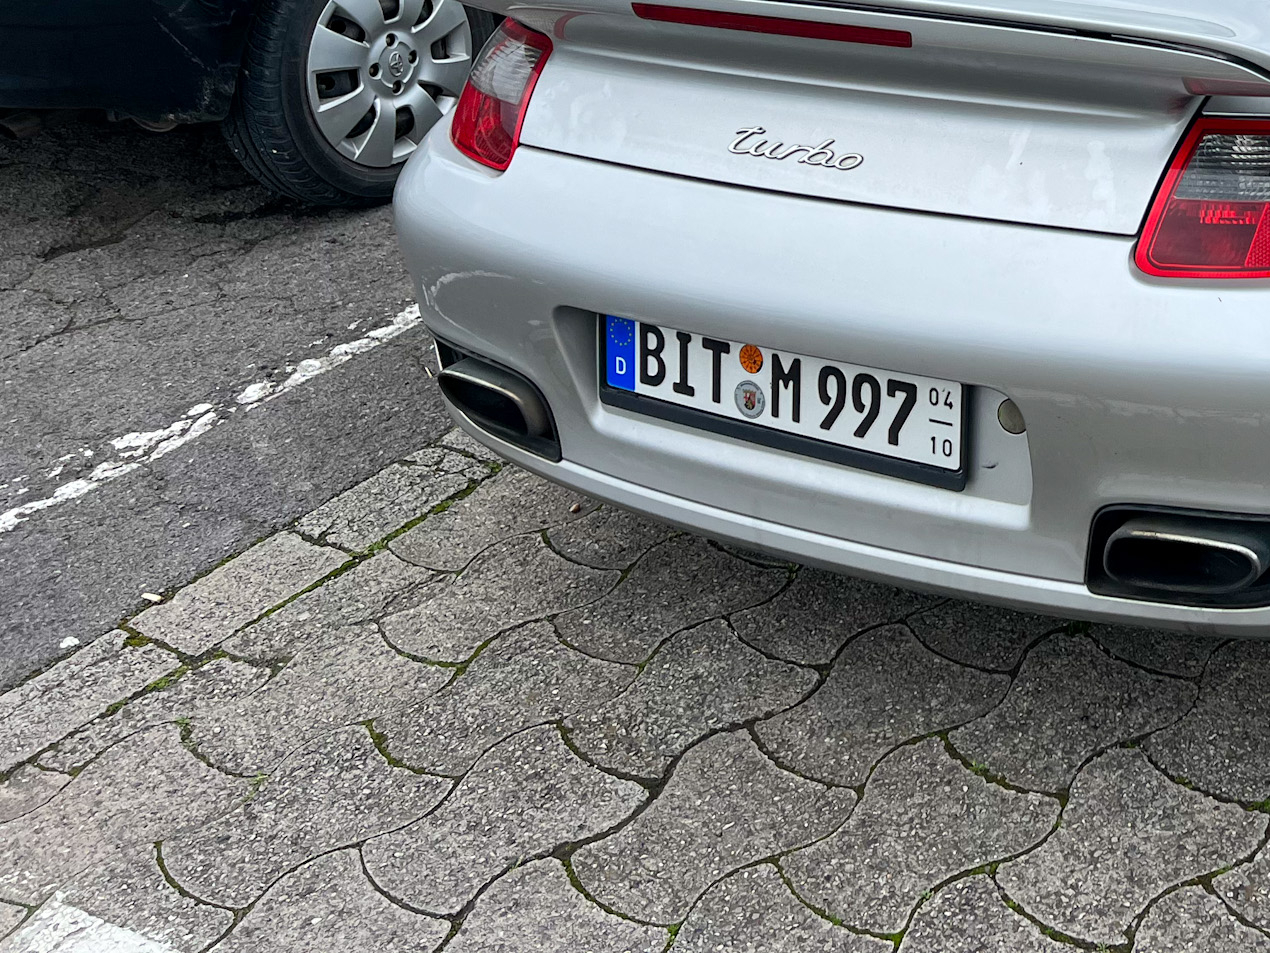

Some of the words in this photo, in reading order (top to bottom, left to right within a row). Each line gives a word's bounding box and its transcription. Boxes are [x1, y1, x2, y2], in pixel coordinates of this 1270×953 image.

[615, 357, 627, 375] D
[639, 322, 731, 404] BIT
[771, 353, 802, 424] M
[818, 365, 918, 447] 997
[929, 386, 954, 410] 04
[930, 436, 953, 458] 10
